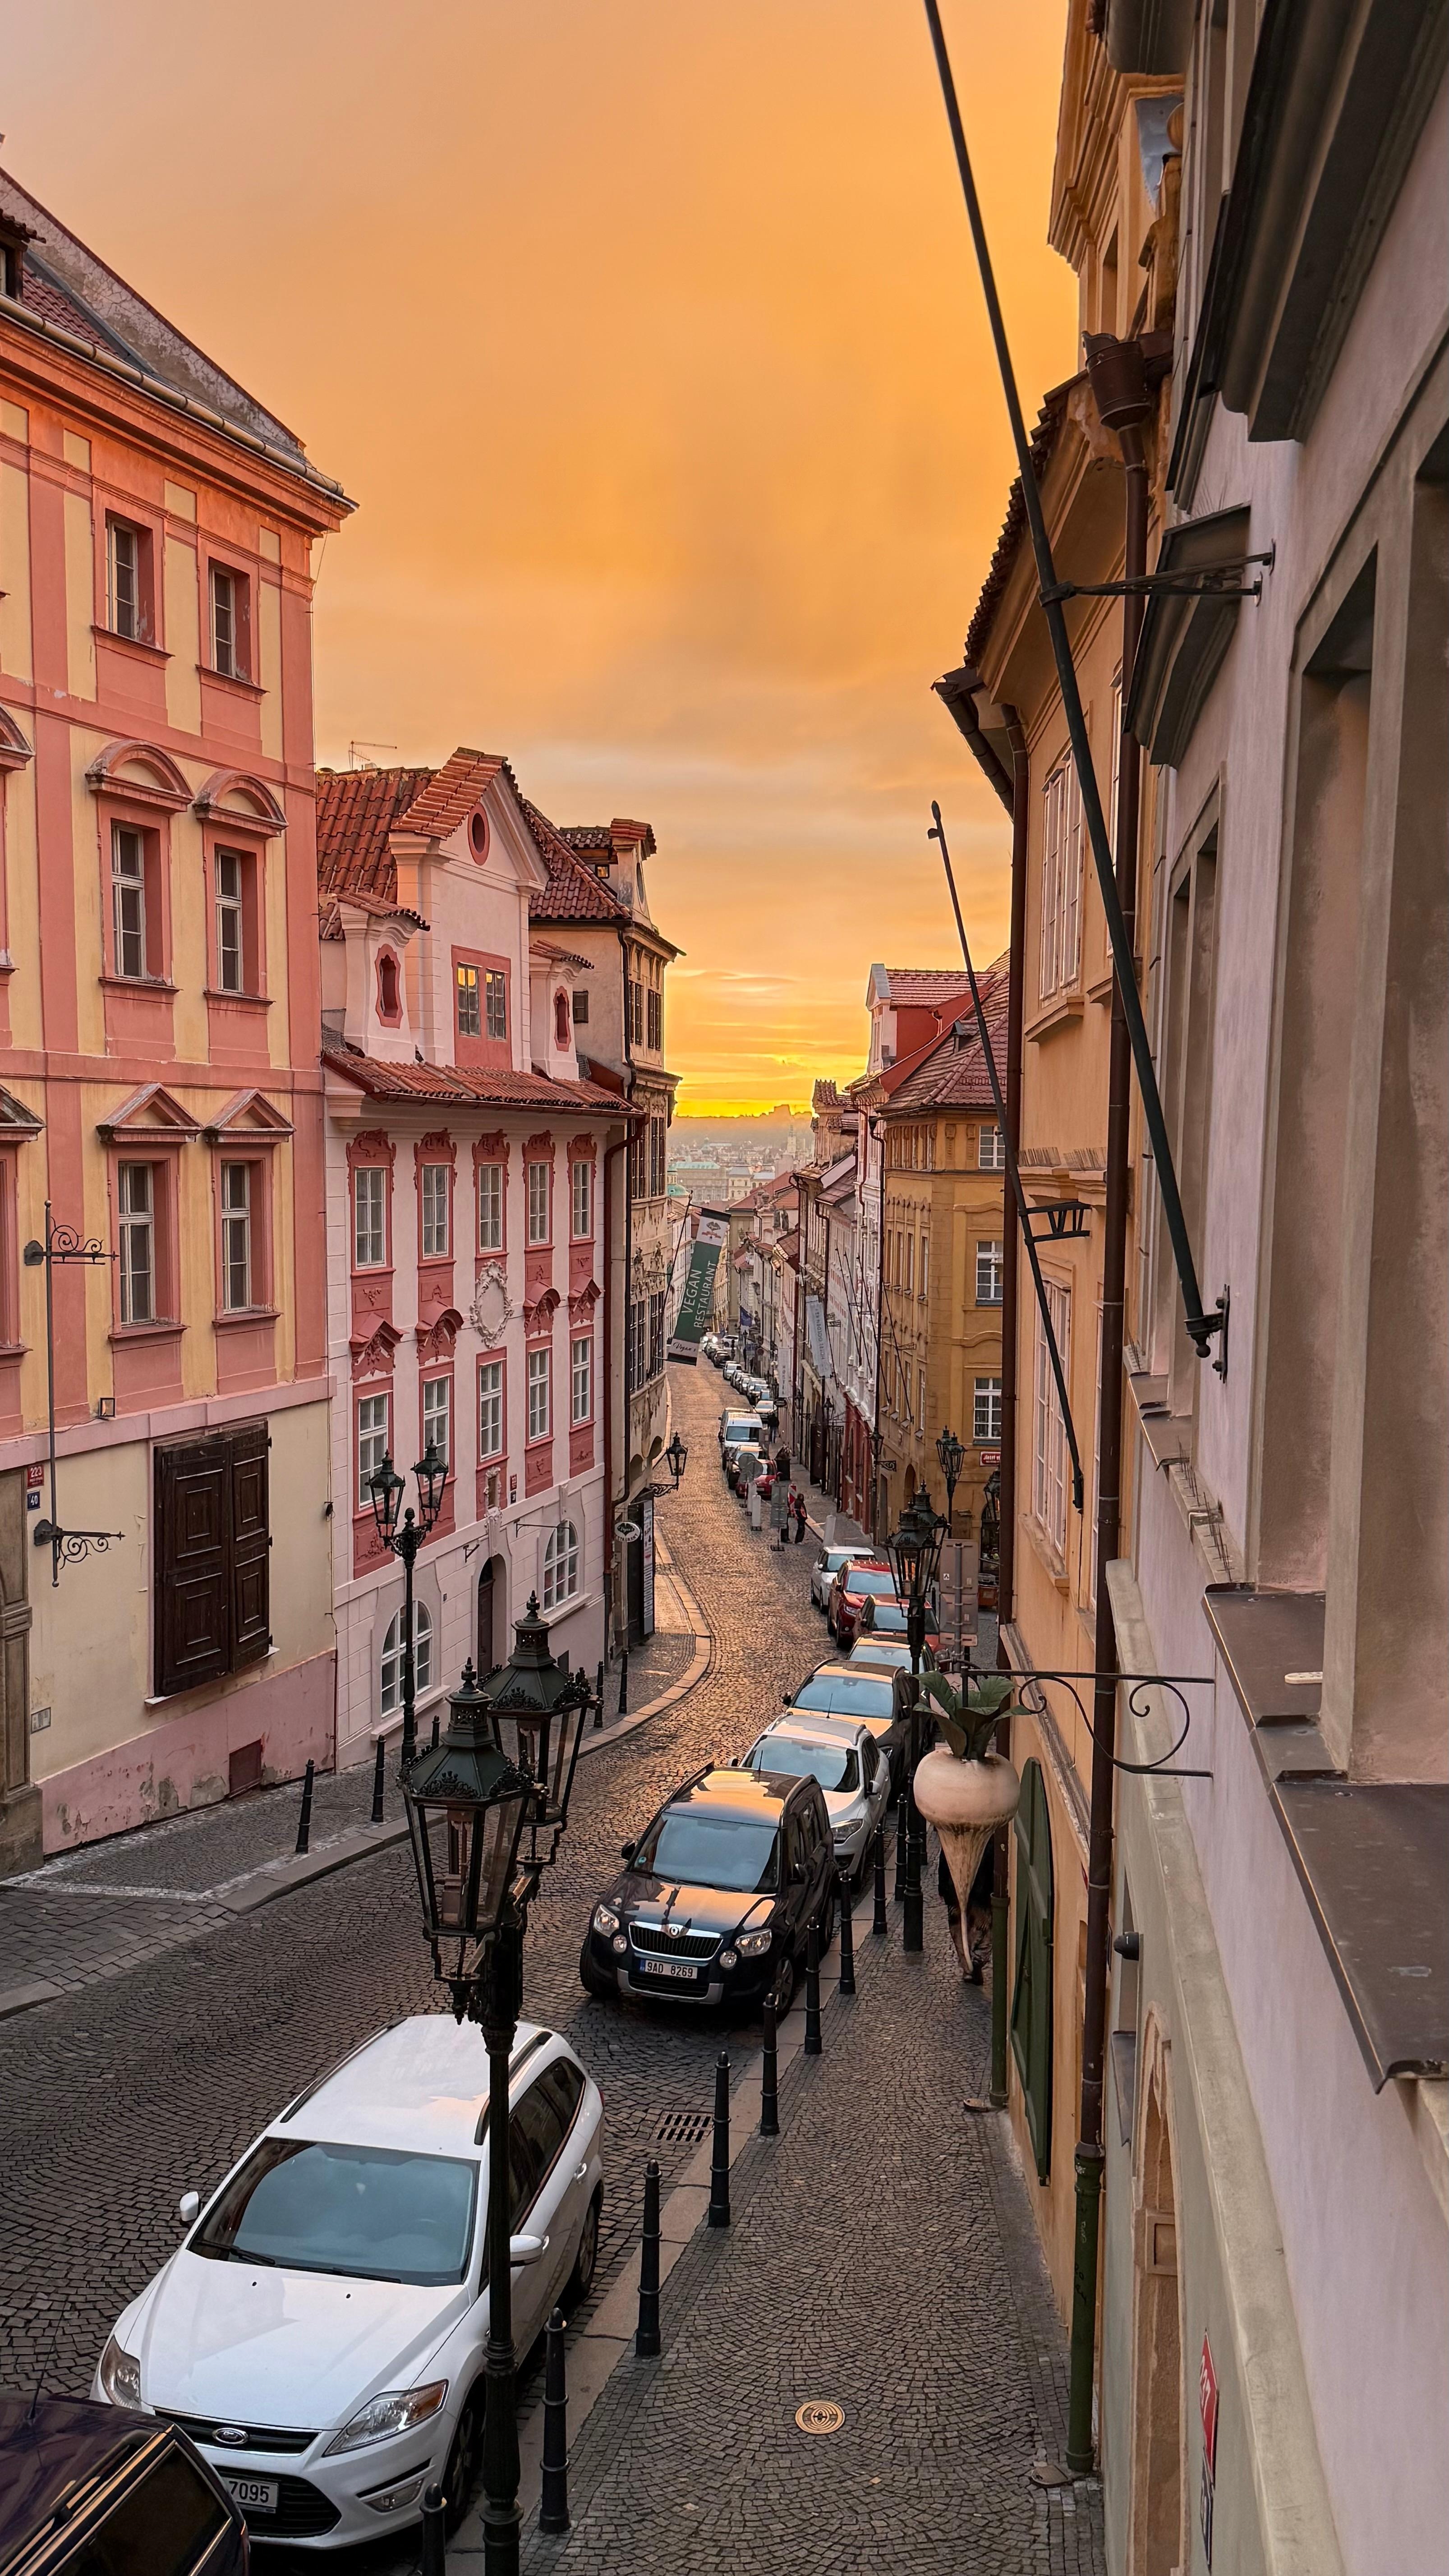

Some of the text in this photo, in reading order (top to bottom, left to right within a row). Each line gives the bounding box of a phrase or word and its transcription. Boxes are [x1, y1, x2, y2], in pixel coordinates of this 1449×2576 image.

[681, 1269, 702, 1314] VEGAN
[694, 1260, 717, 1328] RESTAURANT
[30, 1466, 42, 1478] 223
[30, 1495, 38, 1505] 40
[647, 1962, 693, 1978] 9AD 8269
[229, 2480, 270, 2503] 7095
